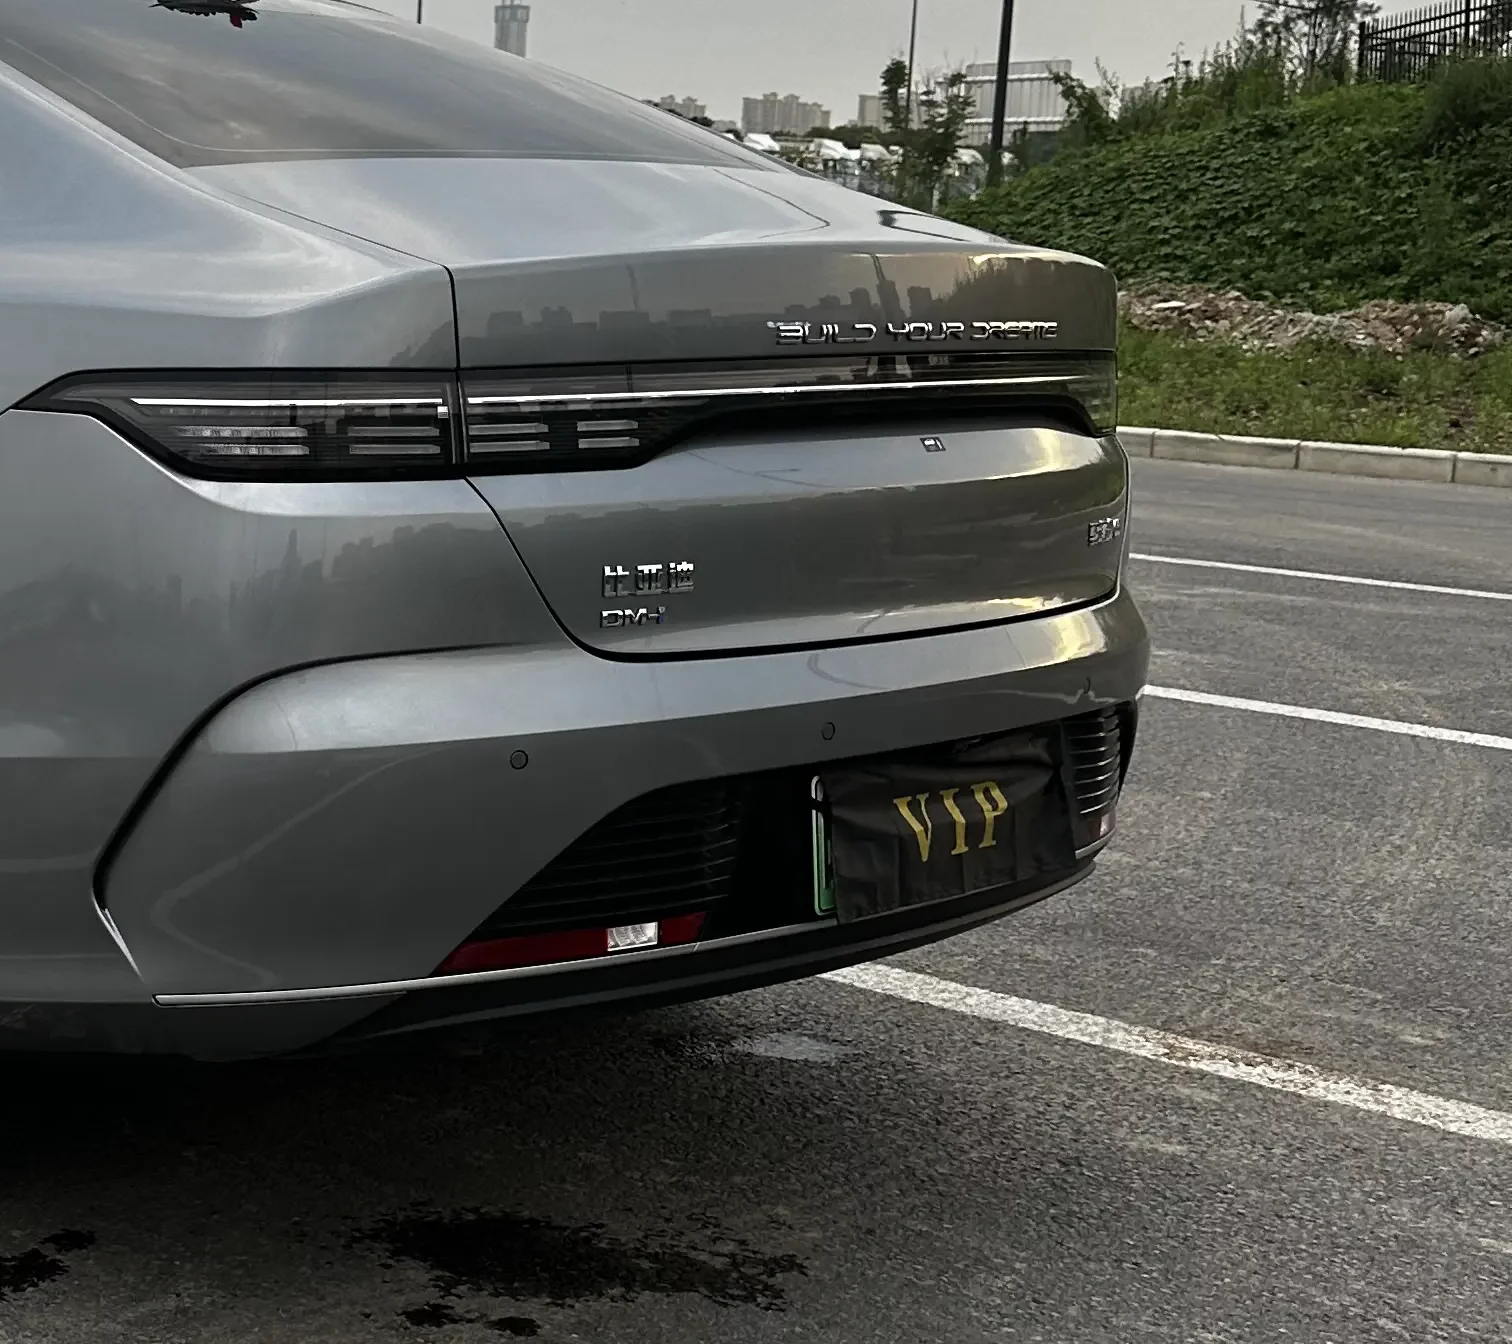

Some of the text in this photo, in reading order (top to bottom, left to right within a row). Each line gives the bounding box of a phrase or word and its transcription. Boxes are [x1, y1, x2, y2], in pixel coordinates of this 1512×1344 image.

[775, 322, 877, 346] BUILD
[887, 321, 965, 343] YOUR
[602, 561, 694, 597] 比亚迪
[893, 780, 1008, 863] VIP
